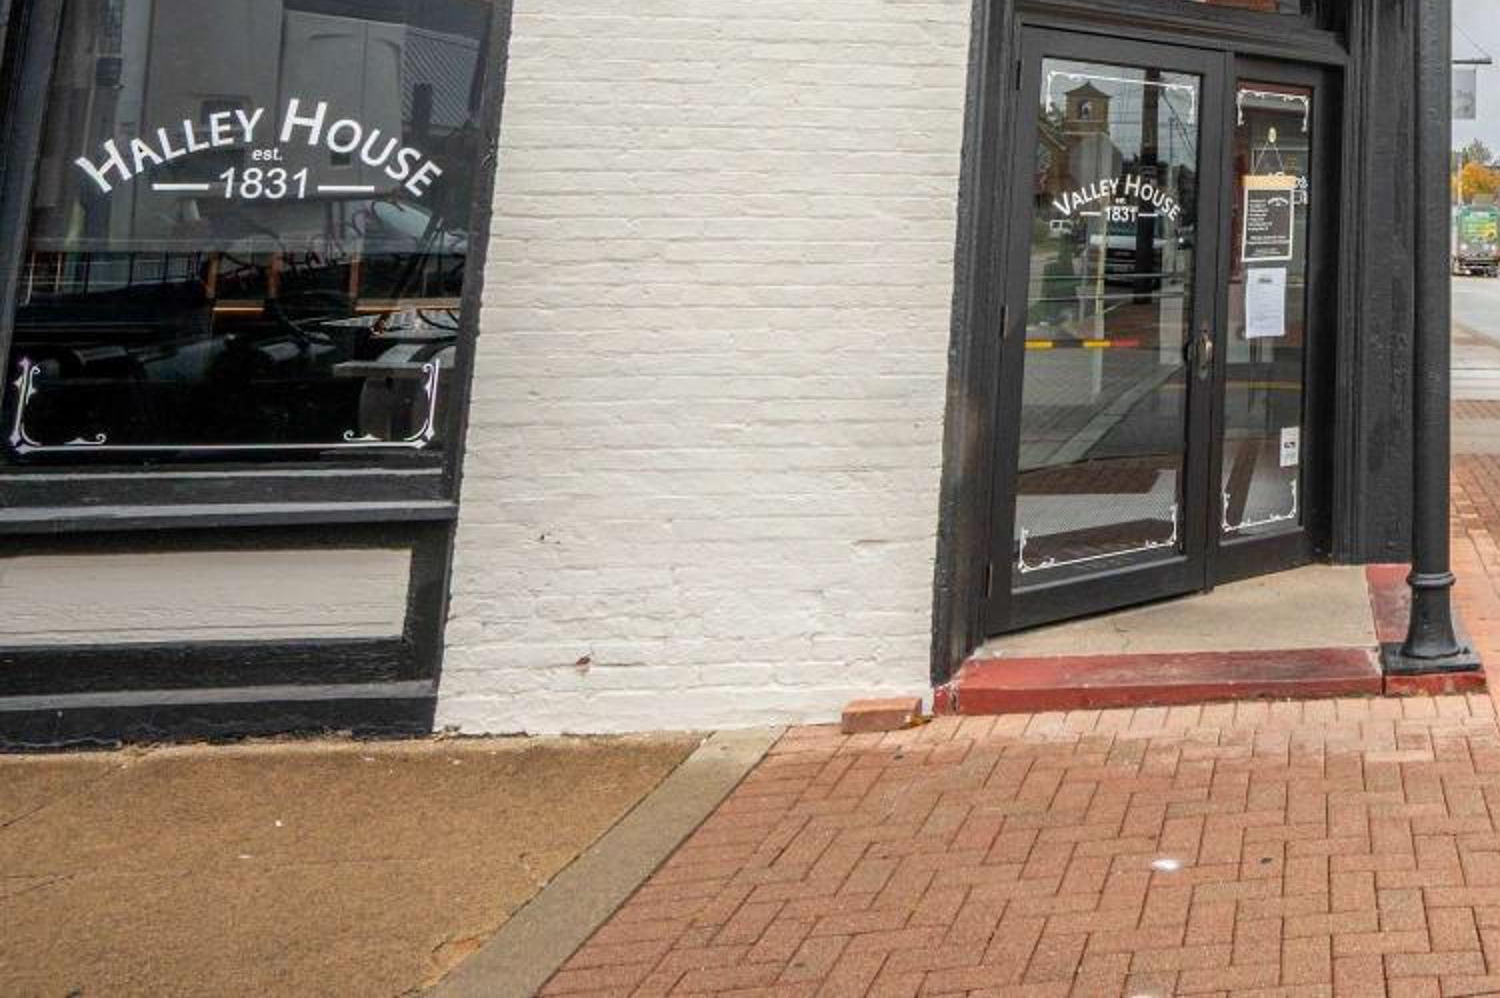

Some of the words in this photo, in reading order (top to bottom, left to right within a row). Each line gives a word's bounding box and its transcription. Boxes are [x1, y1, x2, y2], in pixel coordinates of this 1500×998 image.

[75, 107, 264, 194] HALLEY
[280, 98, 443, 197] HOUSE
[251, 146, 283, 162] est.
[219, 167, 309, 199] 1831
[1053, 177, 1119, 216] VALLEY
[1125, 173, 1181, 221] HOUSE
[1105, 206, 1138, 222] 1831
